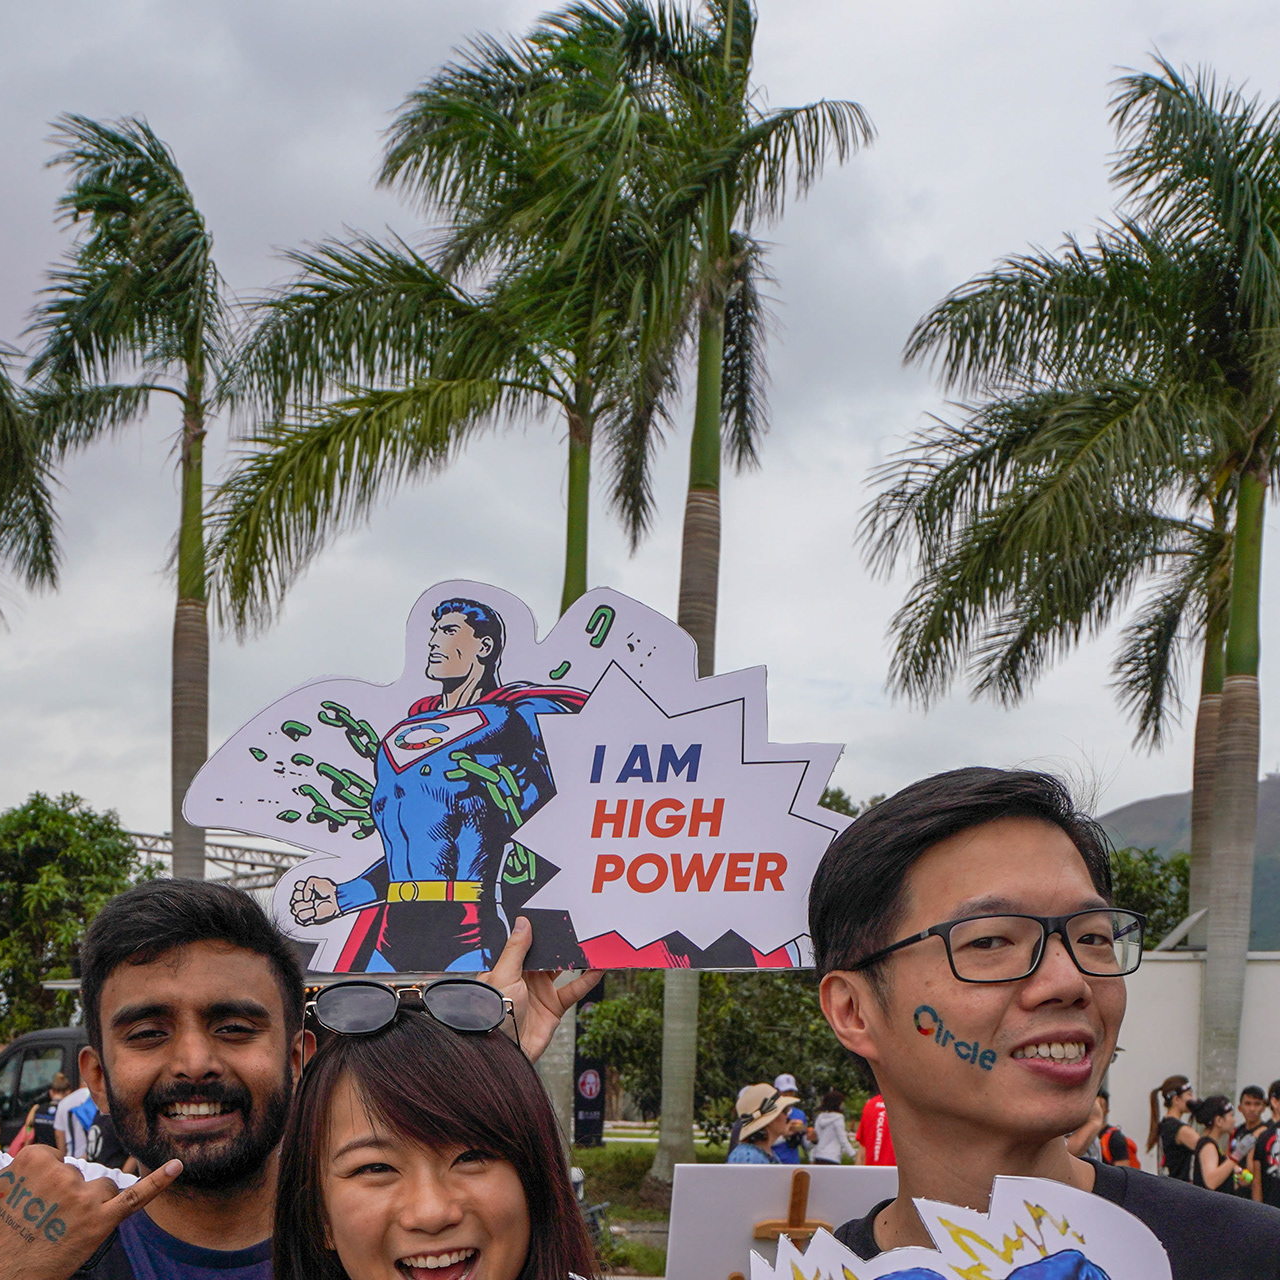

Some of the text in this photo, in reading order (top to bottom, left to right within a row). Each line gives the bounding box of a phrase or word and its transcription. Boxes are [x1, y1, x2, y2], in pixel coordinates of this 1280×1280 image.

[589, 743, 703, 784] I AM
[589, 797, 726, 839] HIGH
[591, 851, 788, 894] POWER
[913, 1004, 998, 1071] Circle
[5, 1214, 22, 1231] Your
[20, 1226, 36, 1243] Life
